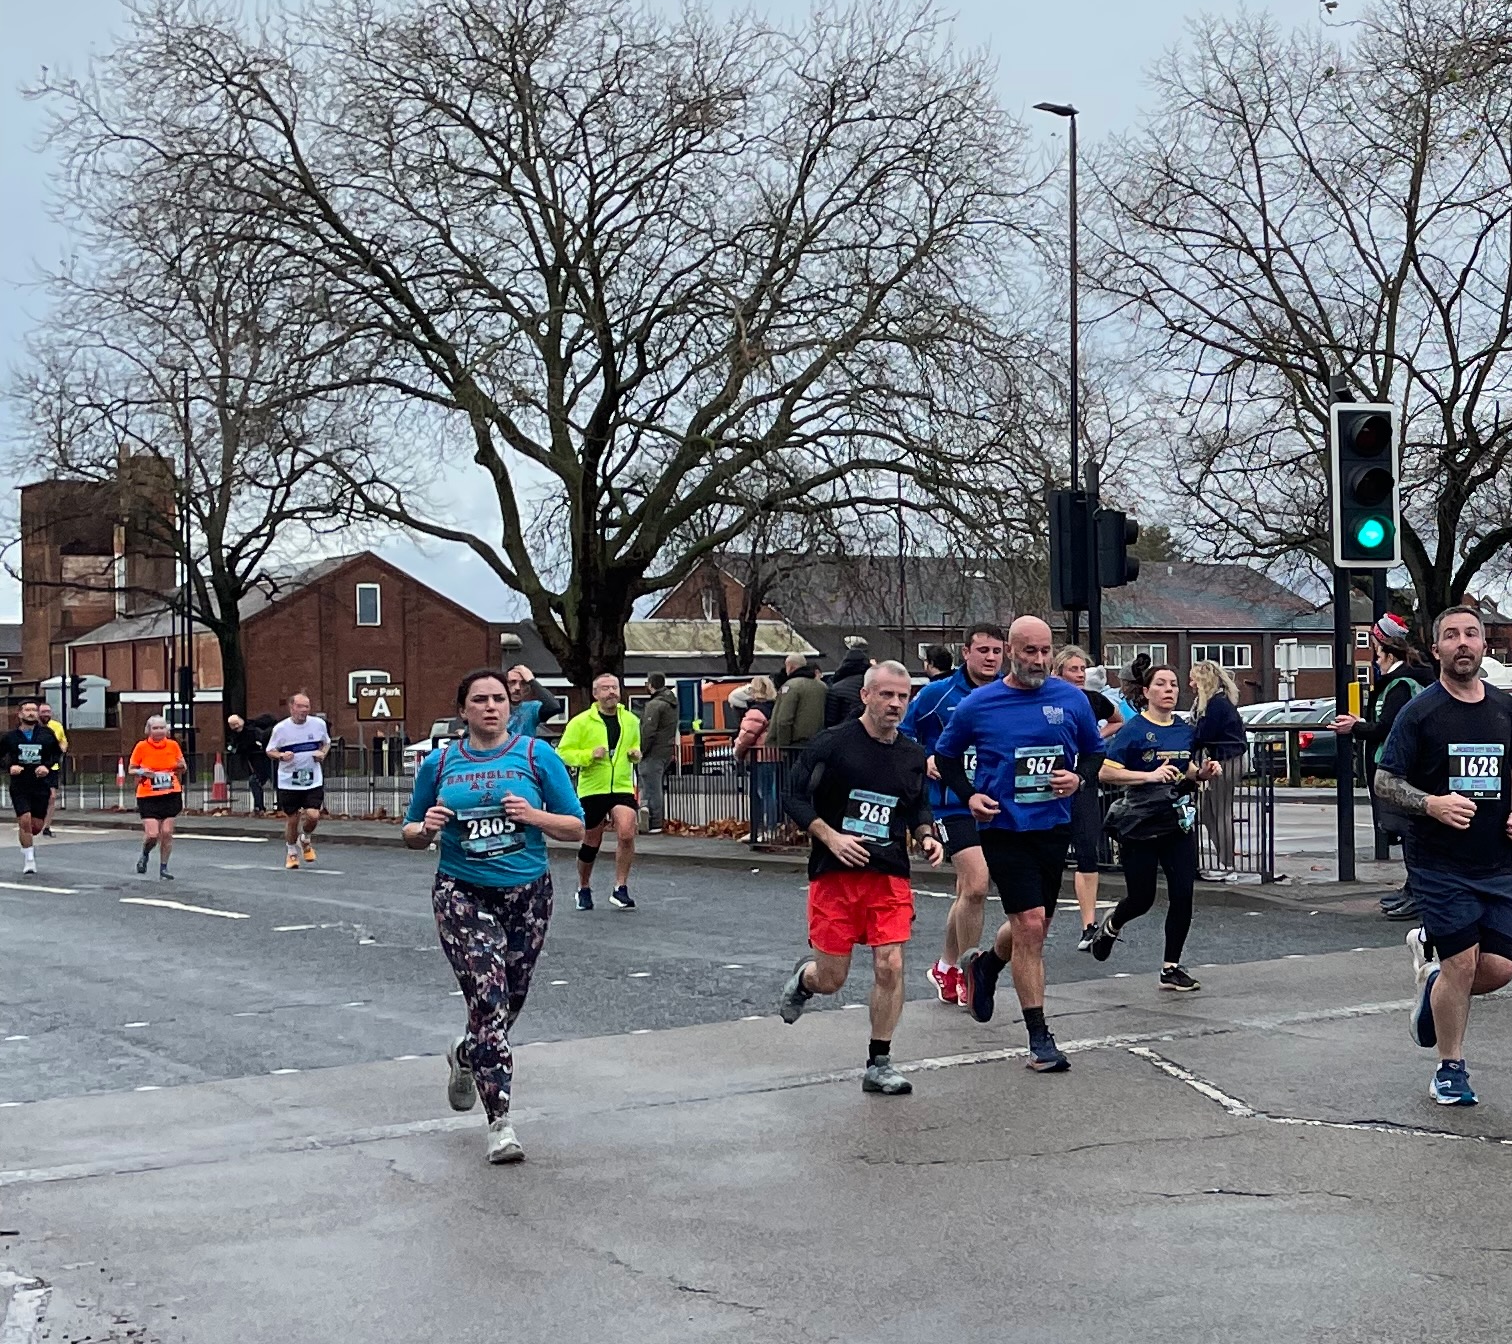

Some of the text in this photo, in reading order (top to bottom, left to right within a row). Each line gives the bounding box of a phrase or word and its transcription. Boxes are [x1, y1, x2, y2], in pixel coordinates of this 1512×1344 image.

[361, 687, 401, 696] Car Park
[372, 697, 391, 717] A
[963, 754, 978, 770] 16
[1026, 756, 1056, 775] 967
[1460, 756, 1499, 777] 1628
[859, 802, 891, 825] 968
[467, 817, 516, 840] 2805
